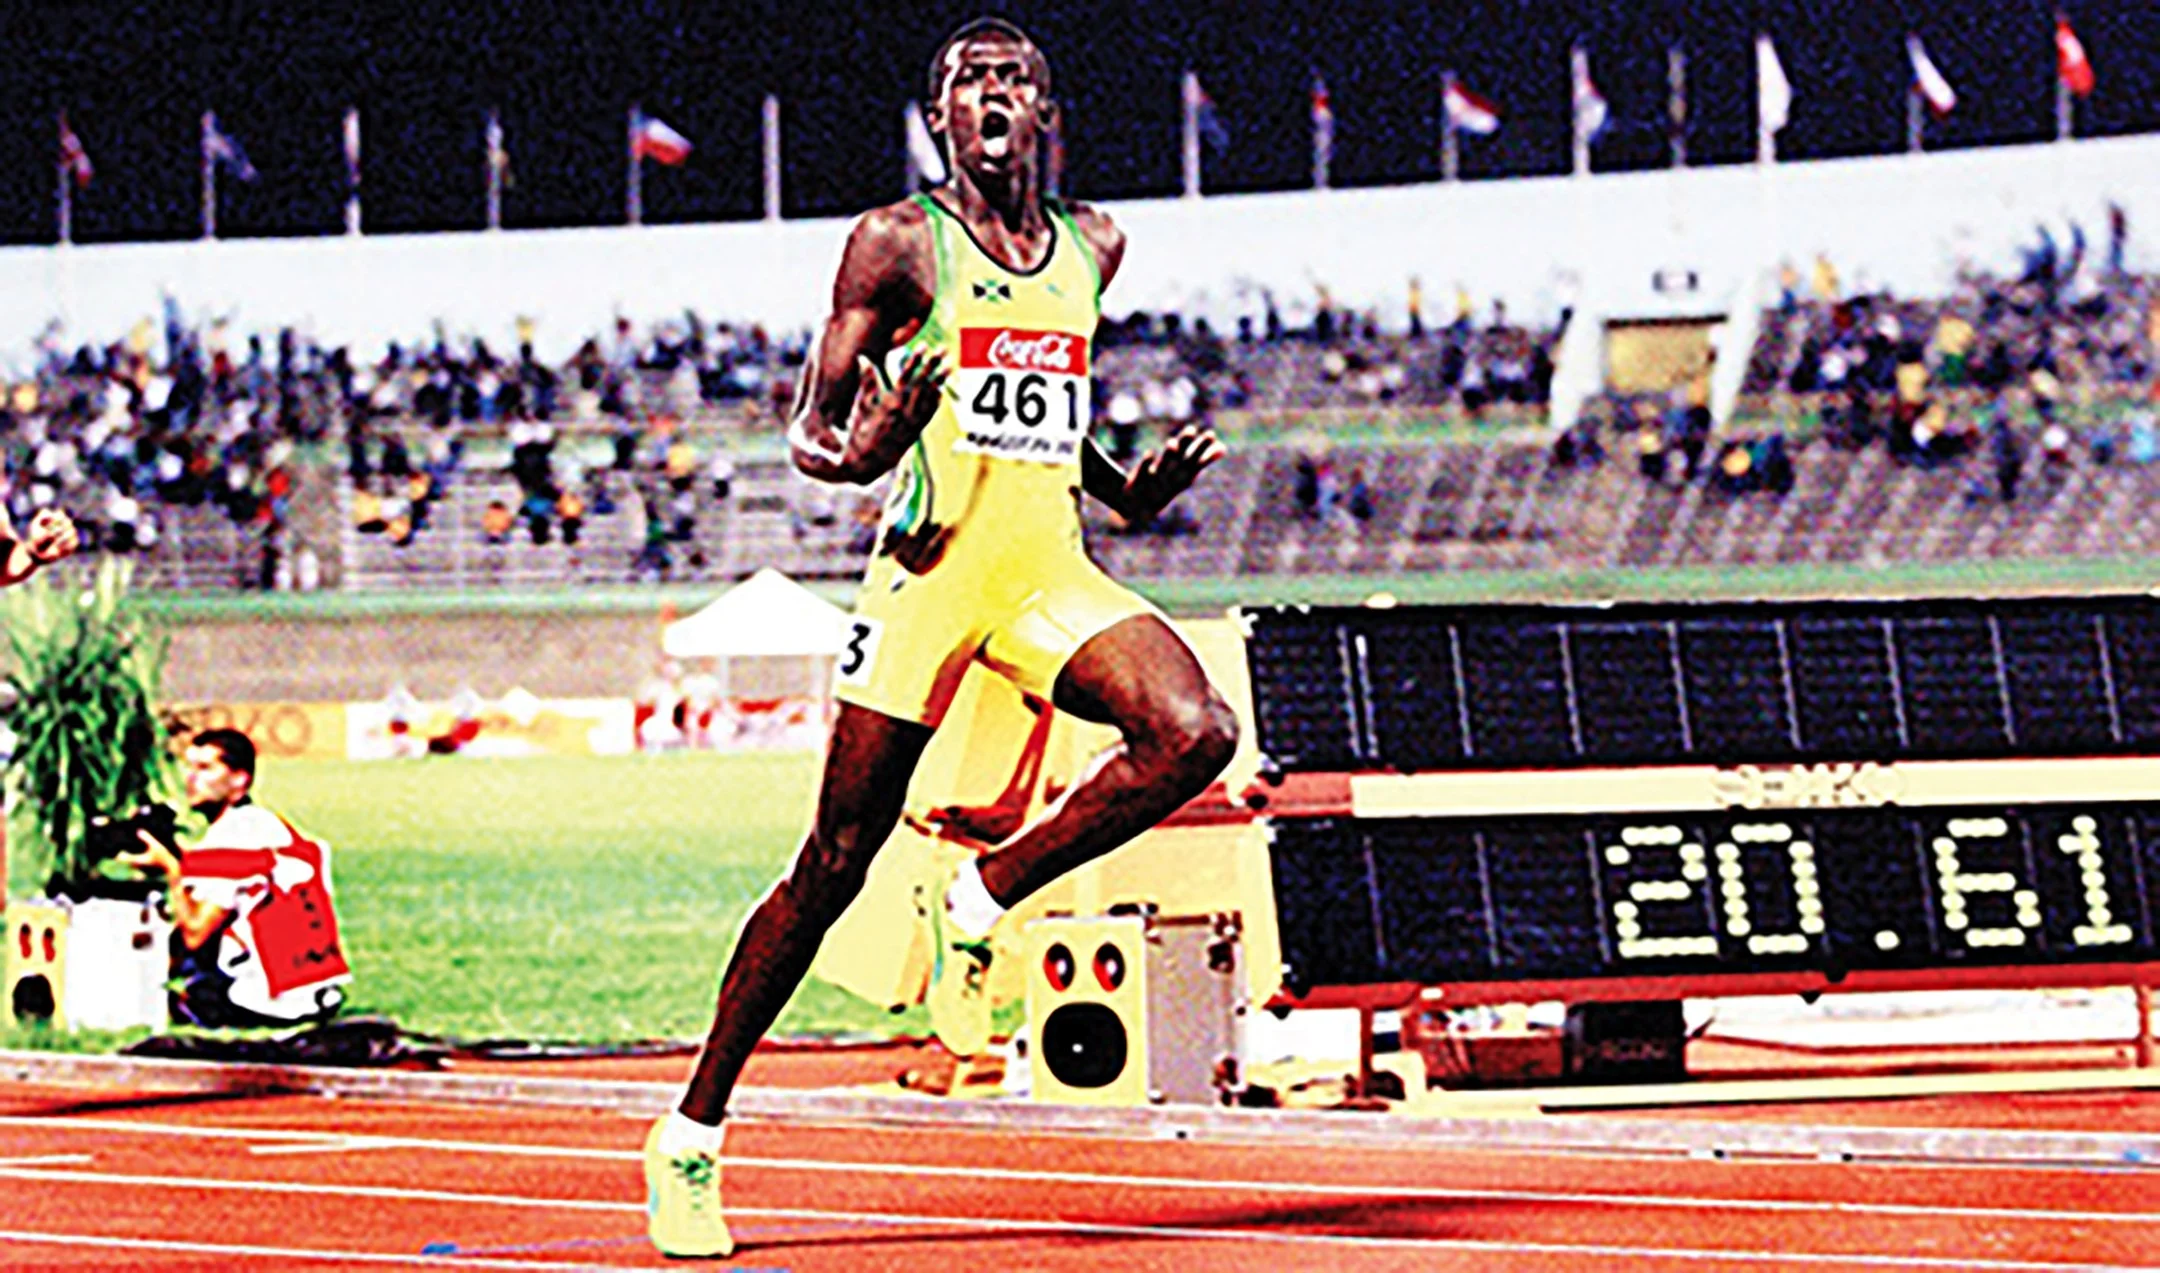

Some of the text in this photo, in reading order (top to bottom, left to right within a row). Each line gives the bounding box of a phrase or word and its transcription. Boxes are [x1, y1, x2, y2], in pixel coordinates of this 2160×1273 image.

[972, 373, 1078, 431] 461
[841, 622, 872, 676] 3
[1604, 814, 2133, 959] 20.61
